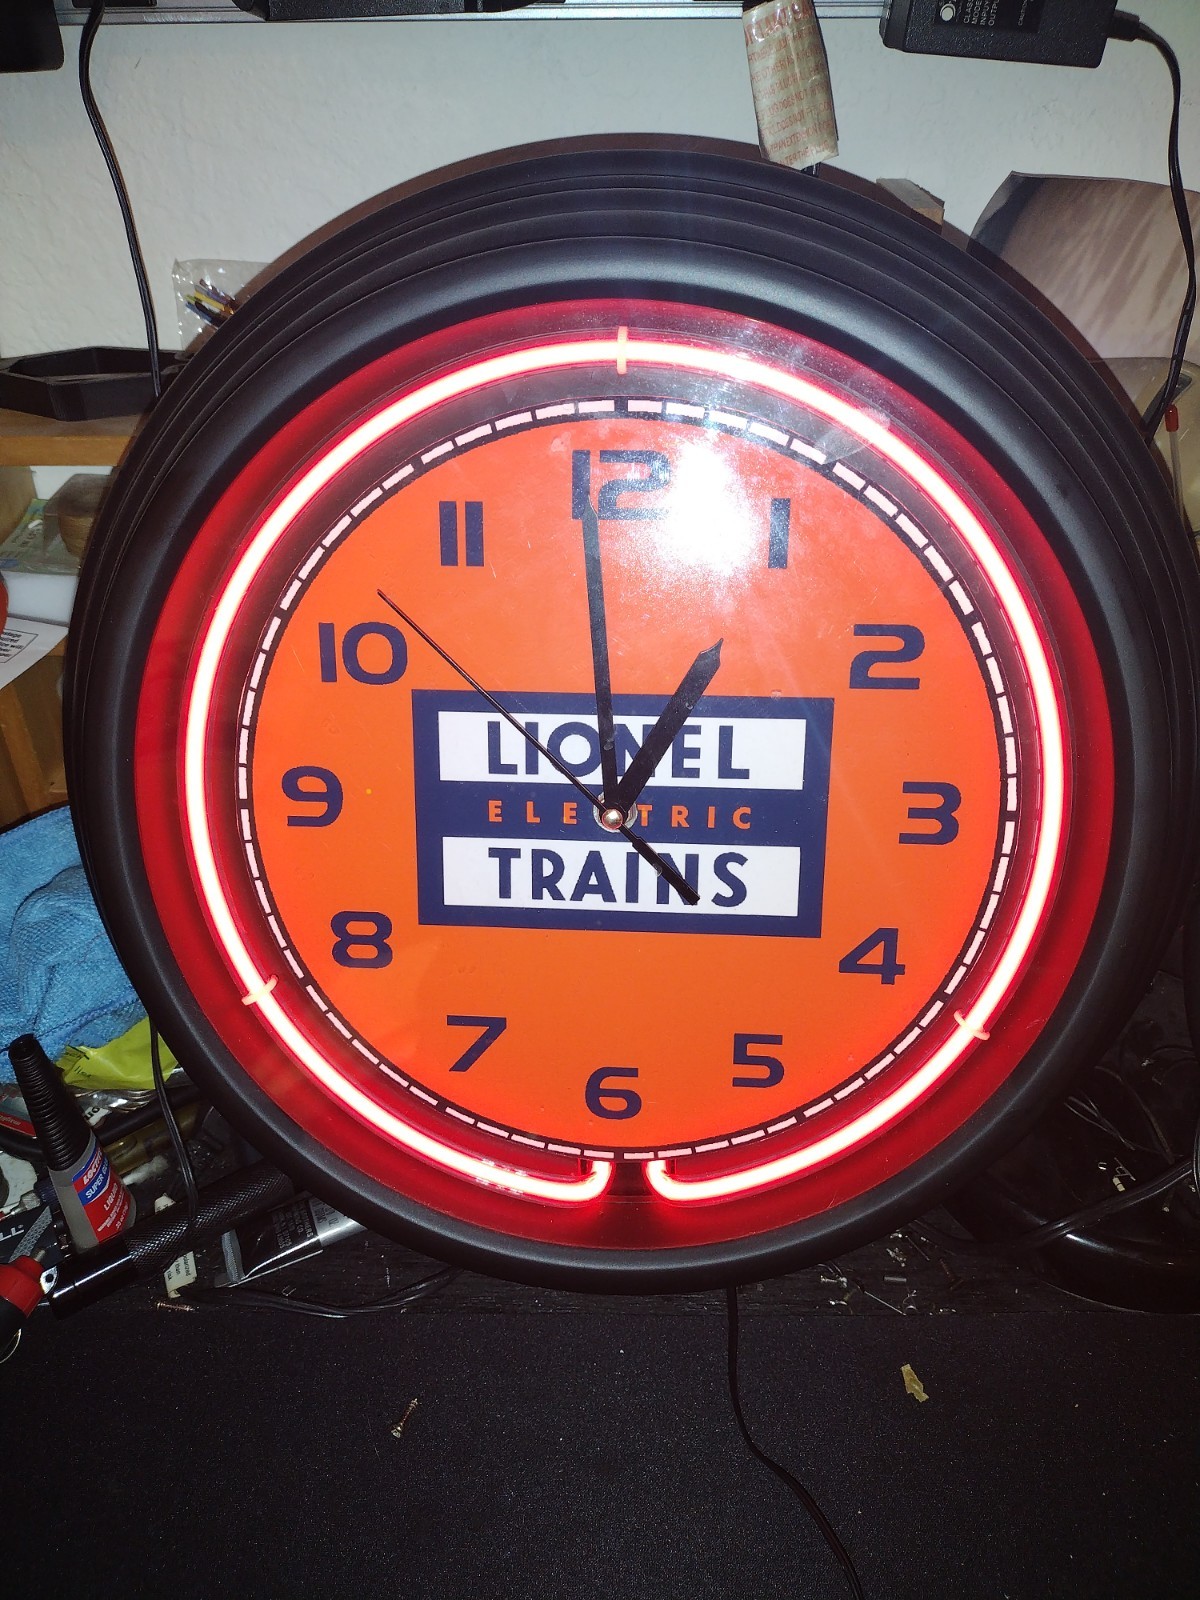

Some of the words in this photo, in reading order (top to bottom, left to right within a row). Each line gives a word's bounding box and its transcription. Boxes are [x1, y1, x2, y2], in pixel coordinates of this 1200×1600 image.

[572, 450, 670, 520] 12
[439, 501, 484, 566] 11
[768, 498, 791, 569] 1
[318, 622, 408, 685] 10
[849, 624, 925, 690] 2
[281, 765, 344, 828] 9
[488, 800, 752, 829] ELETRIC
[898, 781, 961, 846] 3
[488, 847, 749, 908] TRAINS
[330, 911, 393, 969] 8
[838, 927, 906, 985] 4
[446, 1015, 507, 1072] 7
[732, 1033, 785, 1088] 5
[584, 1066, 643, 1120] 6
[85, 1173, 104, 1199] SUPER
